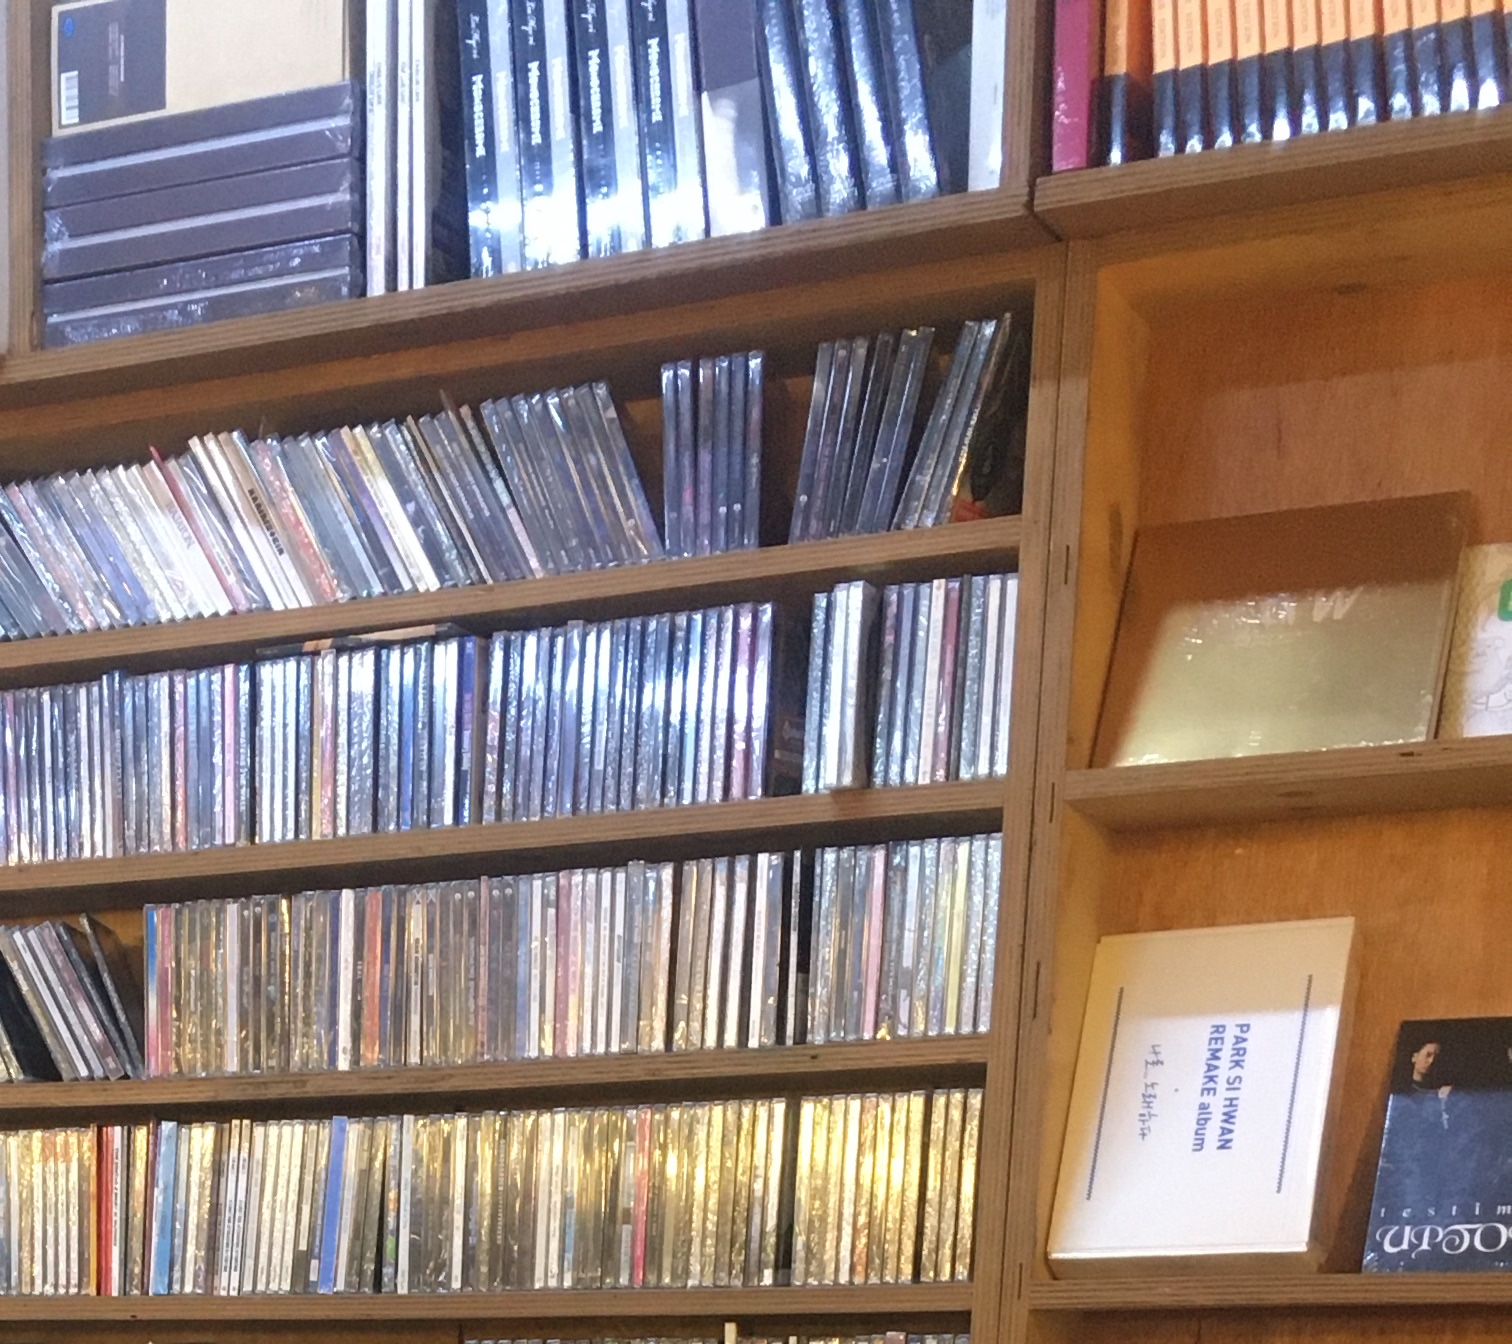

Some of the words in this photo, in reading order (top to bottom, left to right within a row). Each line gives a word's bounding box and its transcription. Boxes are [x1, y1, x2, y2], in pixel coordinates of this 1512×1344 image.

[1200, 1023, 1227, 1098] REMAKE
[1230, 1022, 1251, 1070] PARK
[1226, 1075, 1244, 1097] SI
[1191, 1101, 1214, 1153] album
[1216, 1098, 1241, 1151] HWAN
[1376, 1222, 1512, 1260] UPTO
